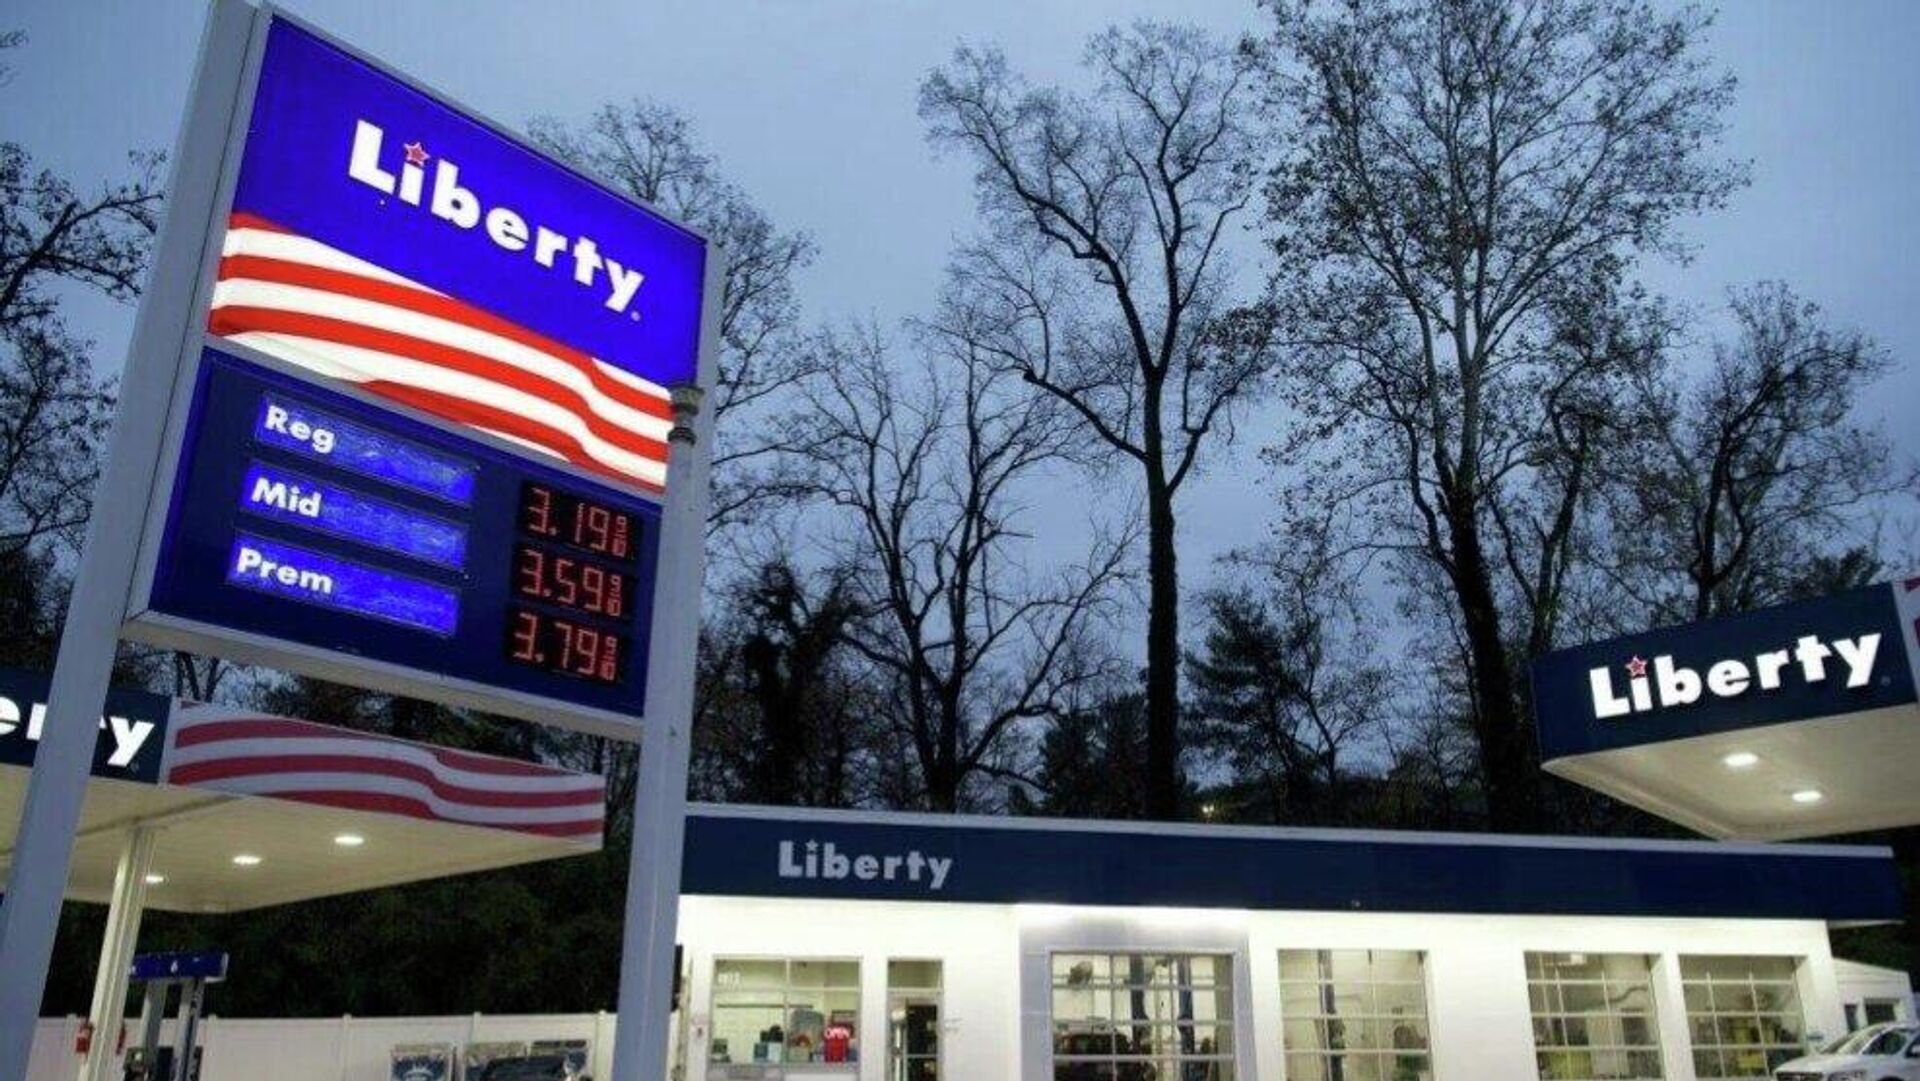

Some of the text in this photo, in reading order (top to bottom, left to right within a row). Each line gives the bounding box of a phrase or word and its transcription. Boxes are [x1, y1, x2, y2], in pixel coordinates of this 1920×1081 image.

[349, 120, 645, 314] Liberty
[264, 404, 335, 454] Reg
[251, 477, 320, 518] Mid
[528, 487, 610, 551] 3.19
[236, 548, 333, 595] Prem
[521, 549, 603, 611] 3.59
[513, 612, 598, 675] 3.79
[1589, 633, 1882, 720] Liberty
[778, 839, 953, 888] Liberty
